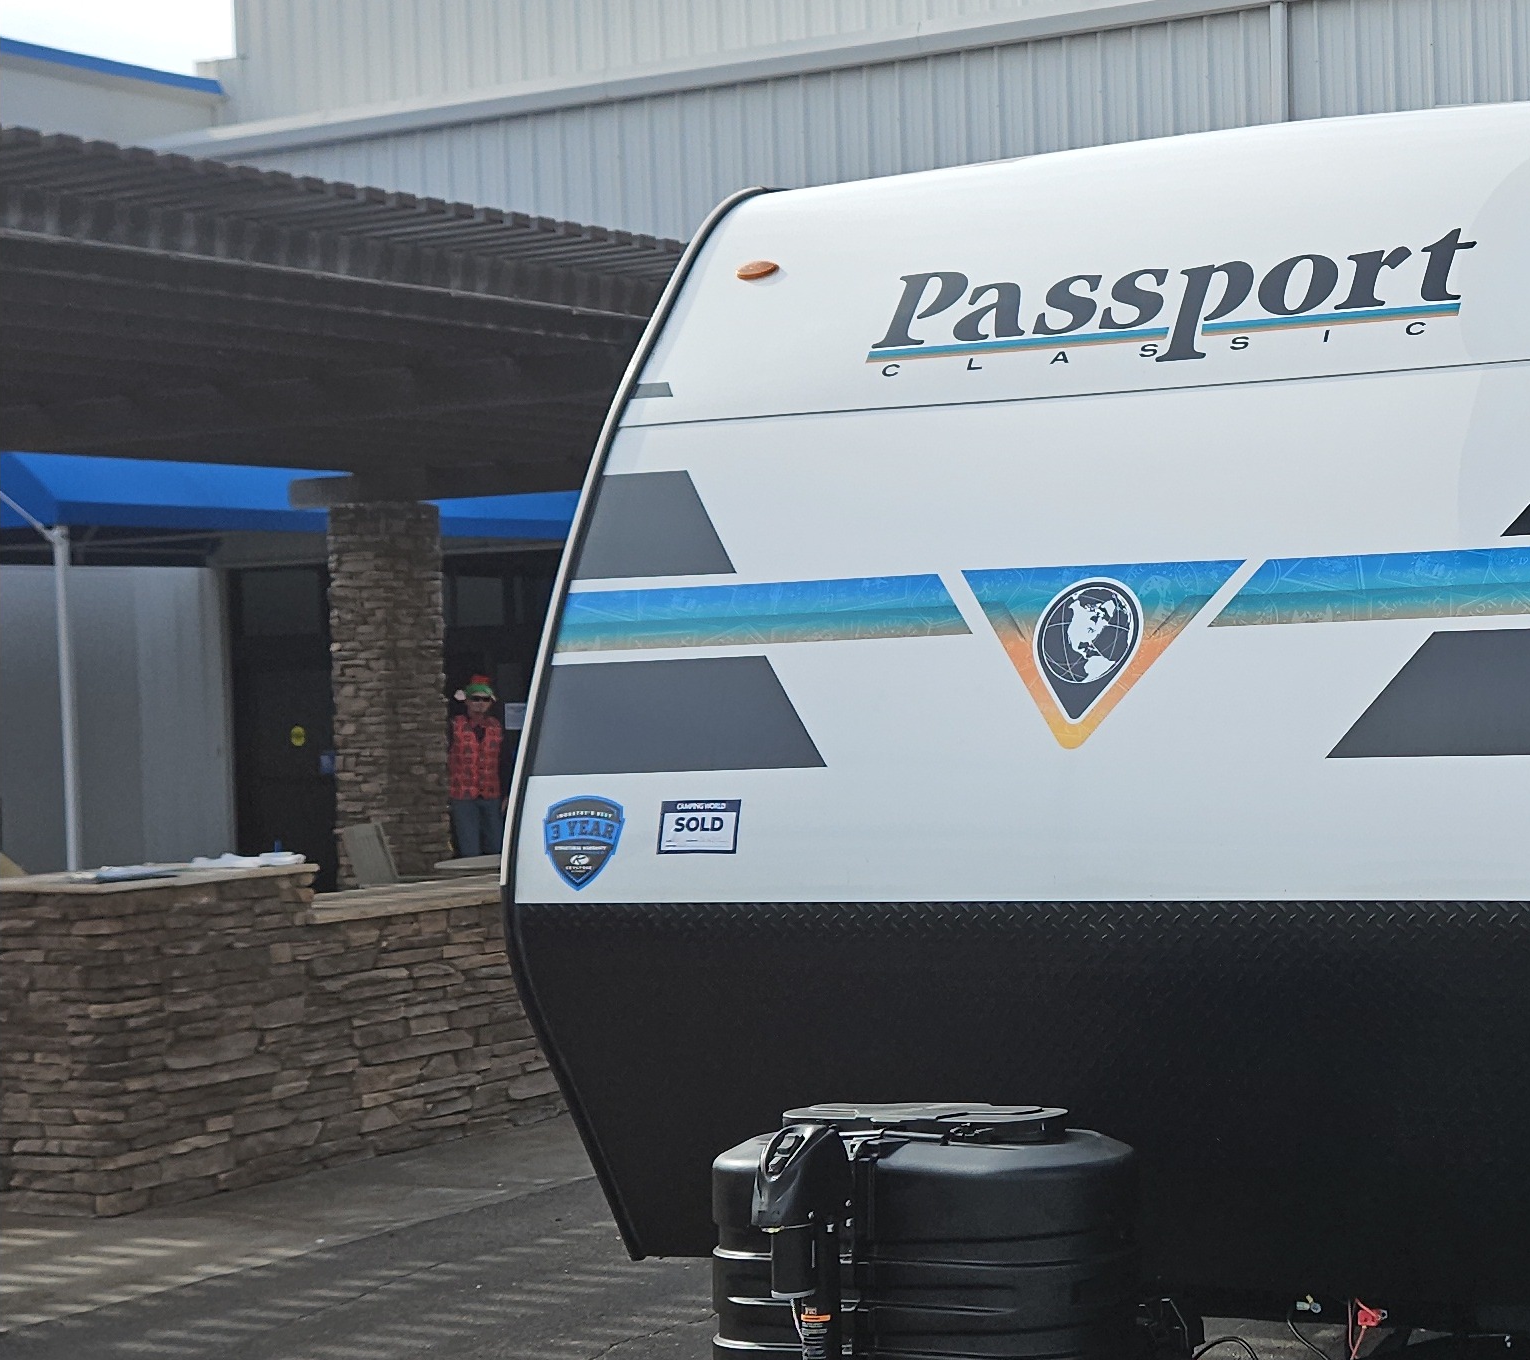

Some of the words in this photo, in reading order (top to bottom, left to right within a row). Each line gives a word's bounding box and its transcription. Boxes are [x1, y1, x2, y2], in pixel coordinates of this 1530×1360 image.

[872, 227, 1478, 362] Passport
[881, 320, 1427, 377] CLASSIC
[551, 823, 560, 840] 3
[567, 819, 615, 840] YEAR
[673, 816, 724, 833] SOLD
